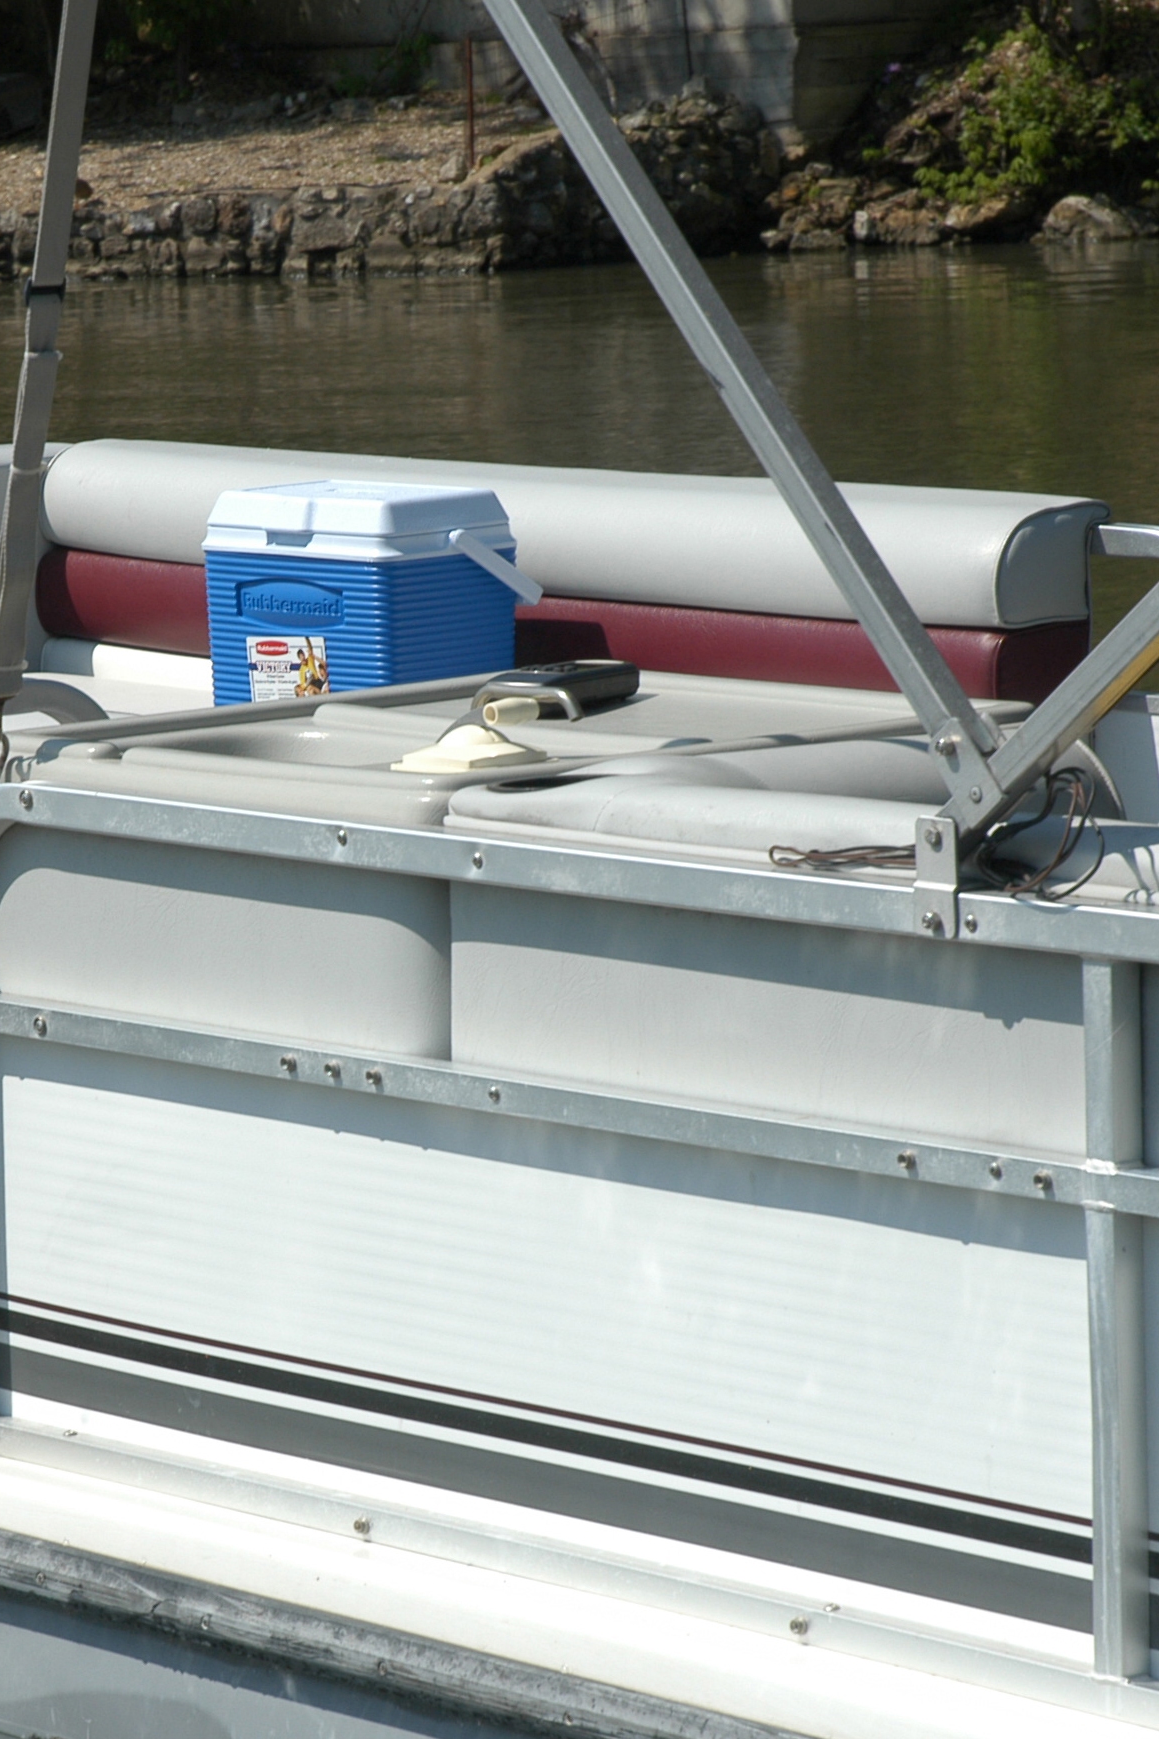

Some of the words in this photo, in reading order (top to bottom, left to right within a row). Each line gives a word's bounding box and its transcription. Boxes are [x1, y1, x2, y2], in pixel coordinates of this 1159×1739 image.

[243, 591, 341, 617] Rubbermaid
[257, 644, 287, 653] Rubbermaid
[255, 660, 291, 673] VICTORY
